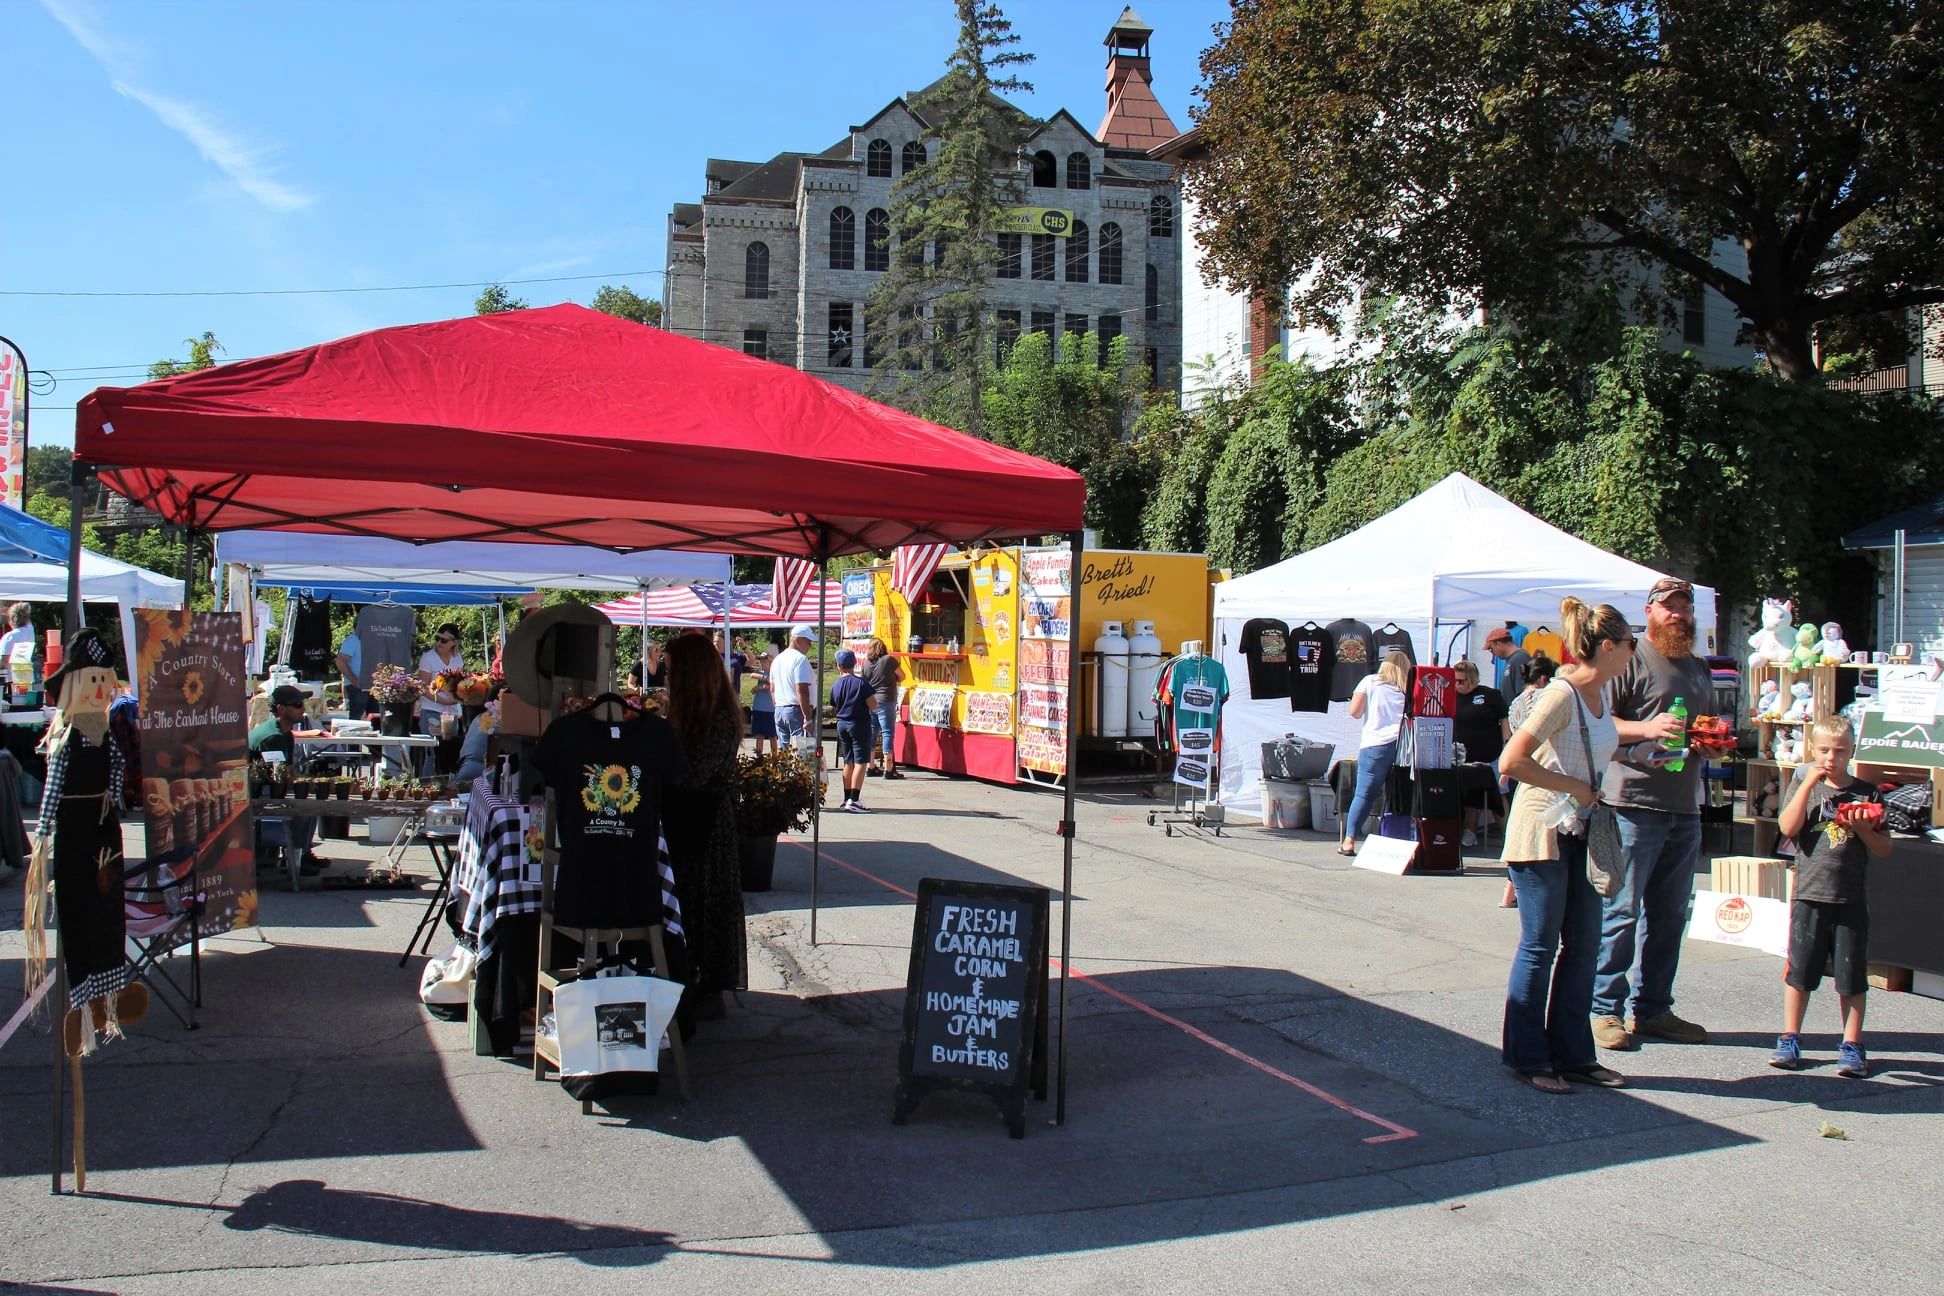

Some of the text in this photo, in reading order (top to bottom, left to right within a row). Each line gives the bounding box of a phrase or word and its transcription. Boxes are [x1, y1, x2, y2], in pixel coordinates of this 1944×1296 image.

[1044, 215, 1065, 229] CHS
[1081, 555, 1134, 585] Brett's
[847, 580, 871, 596] OREO
[1097, 574, 1155, 605] Fried!
[1028, 601, 1055, 617] CHICKEN
[1041, 621, 1068, 636] TENDERS
[1046, 649, 1069, 663] SOFT
[148, 673, 158, 690] A
[161, 654, 237, 687] Country Store
[142, 716, 153, 730] at
[153, 710, 174, 729] The
[209, 705, 239, 724] House
[1860, 738, 1898, 747] EDDIE
[202, 874, 223, 887] 1889
[940, 905, 1017, 935] FRESH
[1718, 909, 1750, 922] RED KAP
[935, 930, 1023, 962] CARAMEL
[954, 956, 1007, 978] CORN
[927, 992, 1020, 1019] HOMEMADE
[947, 1015, 997, 1039] JAM
[932, 1045, 1009, 1071] BUTTERS
